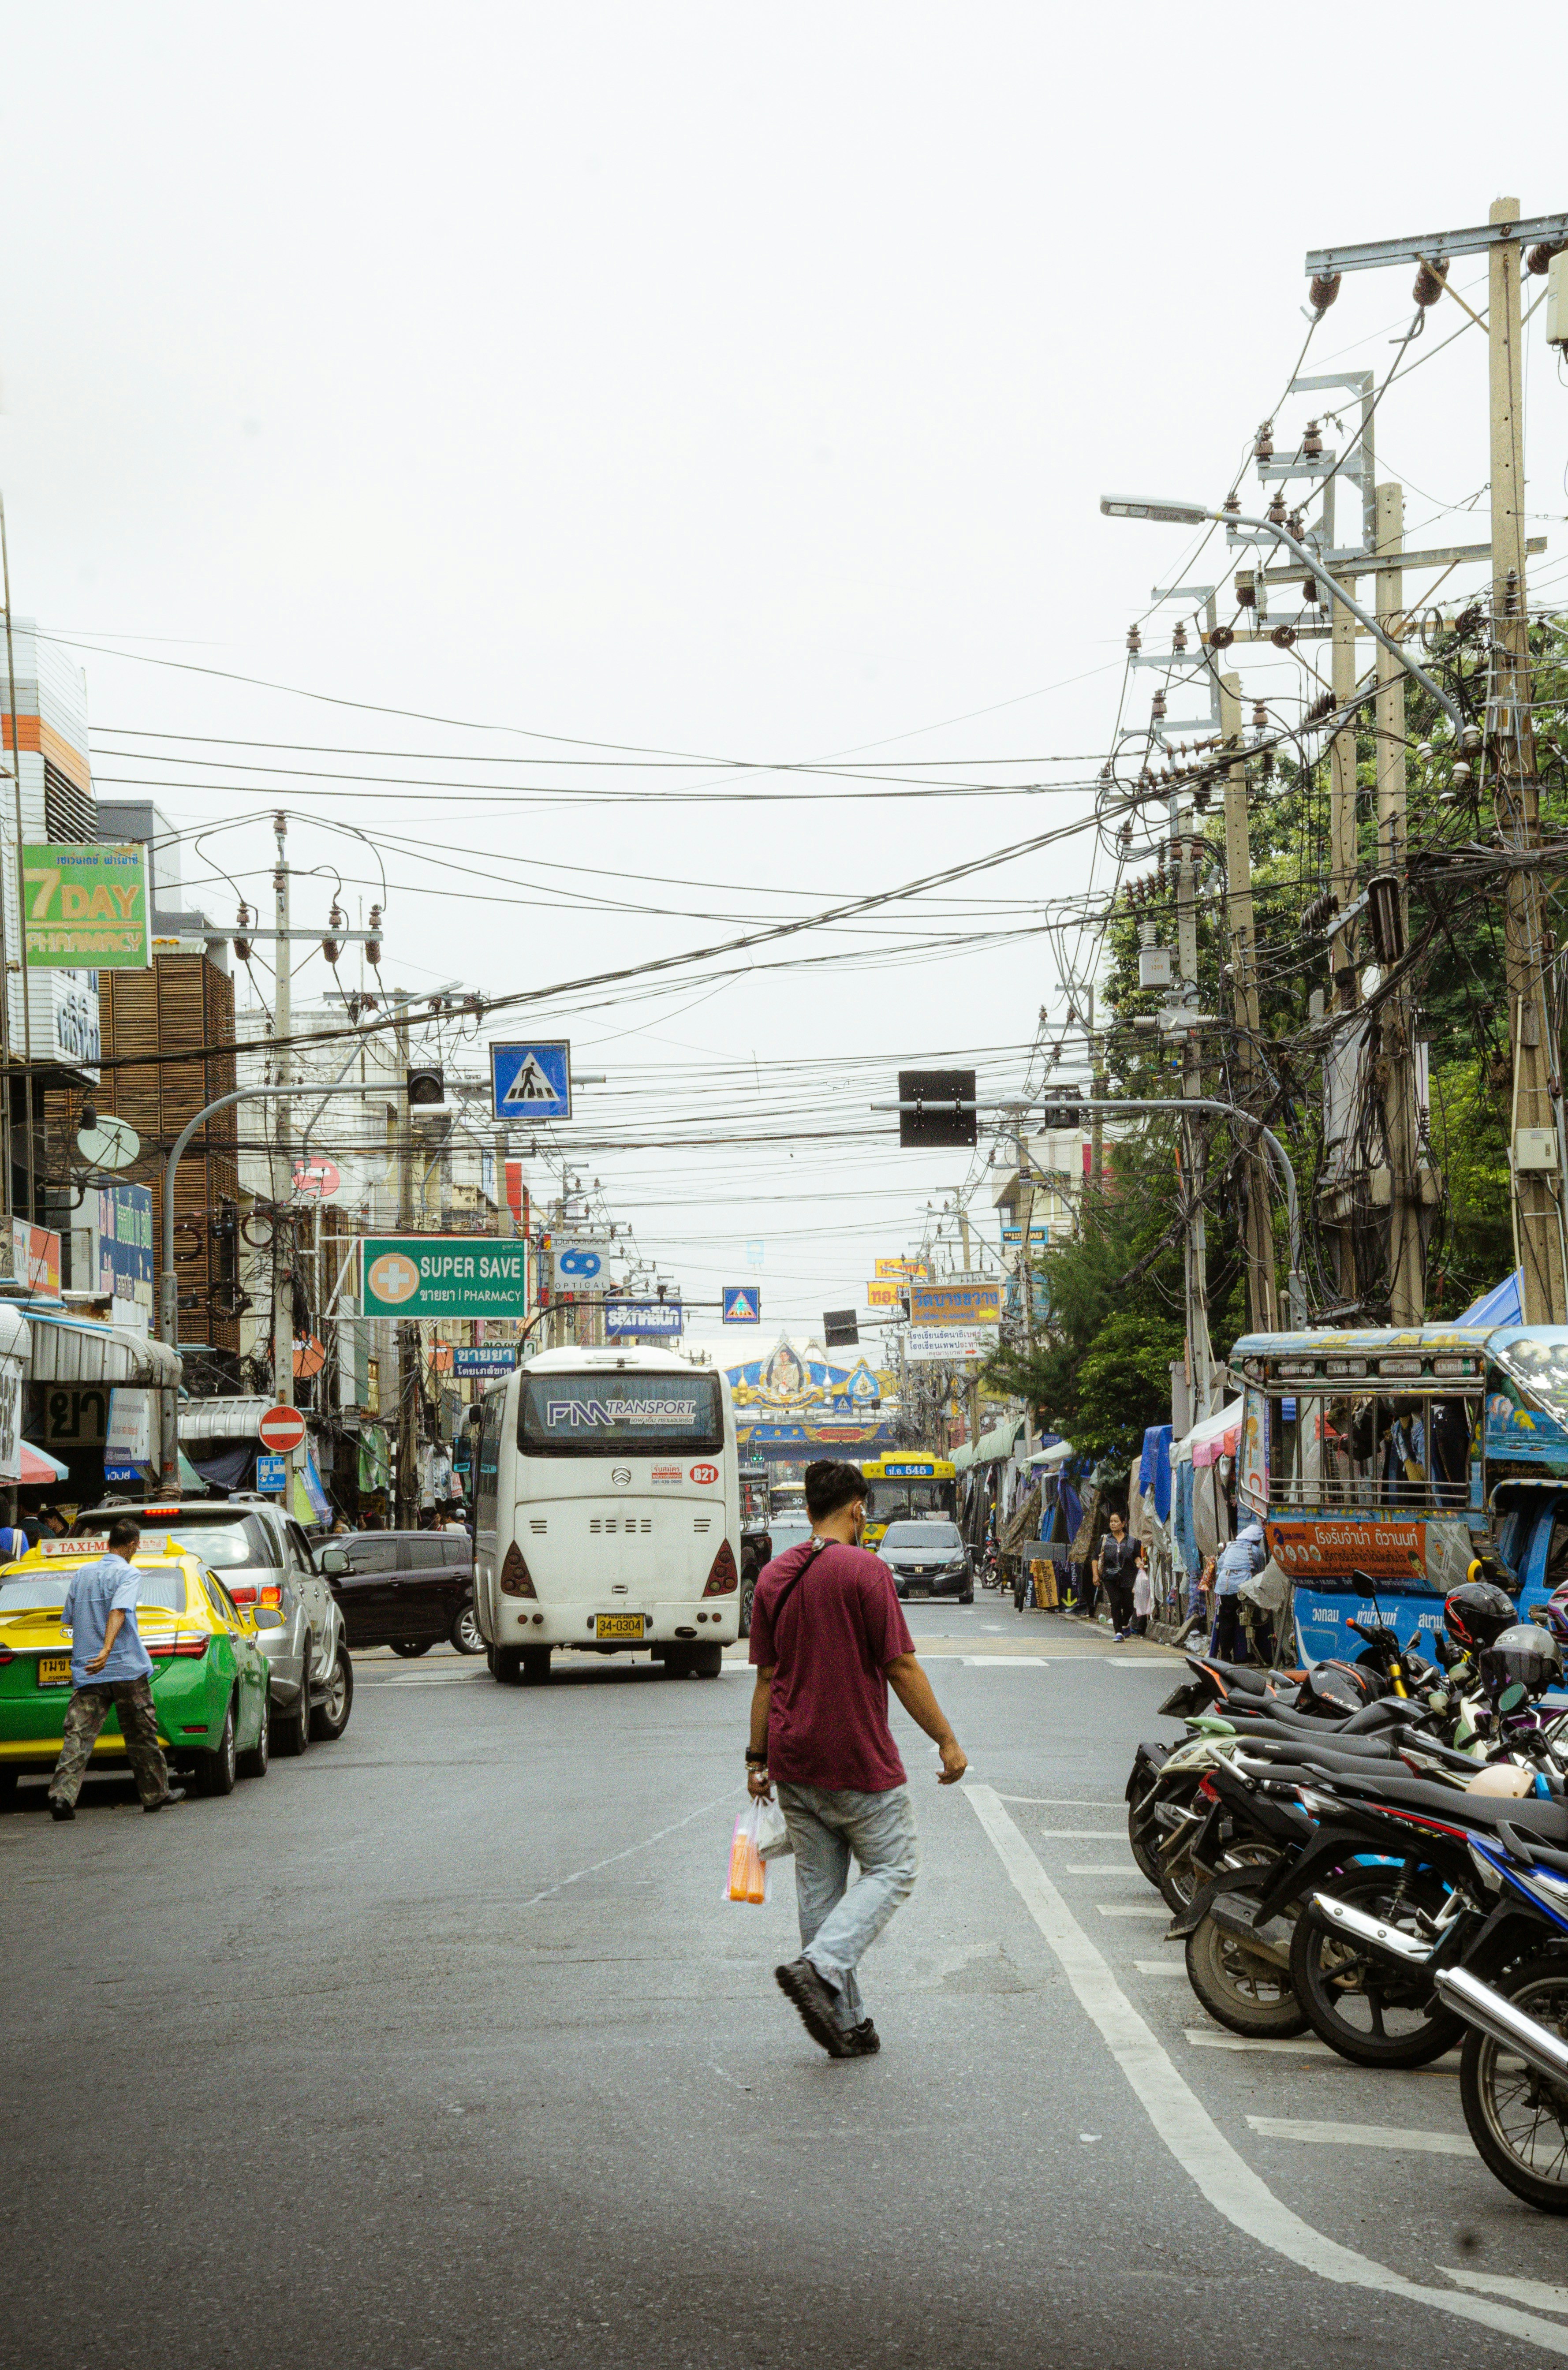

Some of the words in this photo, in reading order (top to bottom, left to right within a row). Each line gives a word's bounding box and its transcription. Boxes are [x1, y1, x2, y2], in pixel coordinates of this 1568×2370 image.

[26, 932, 143, 952] PHARMACY
[420, 1256, 474, 1278] SUPER
[480, 1257, 521, 1278] SAVE
[420, 1289, 455, 1301] ขายยา
[464, 1290, 521, 1302] PHARMACY
[914, 1289, 999, 1308] วัดบางขวาง
[458, 1349, 512, 1361] ขายยา
[49, 1391, 106, 1438] ยา
[607, 1400, 695, 1415] TRANSPORT
[694, 1468, 714, 1481] B21
[905, 1465, 926, 1475] 545
[1314, 1526, 1371, 1546] โรงรับจำนำ
[1375, 1527, 1419, 1547] ติวานนท์
[1312, 1609, 1339, 1623] วงกลม
[600, 1620, 641, 1631] 34-0304
